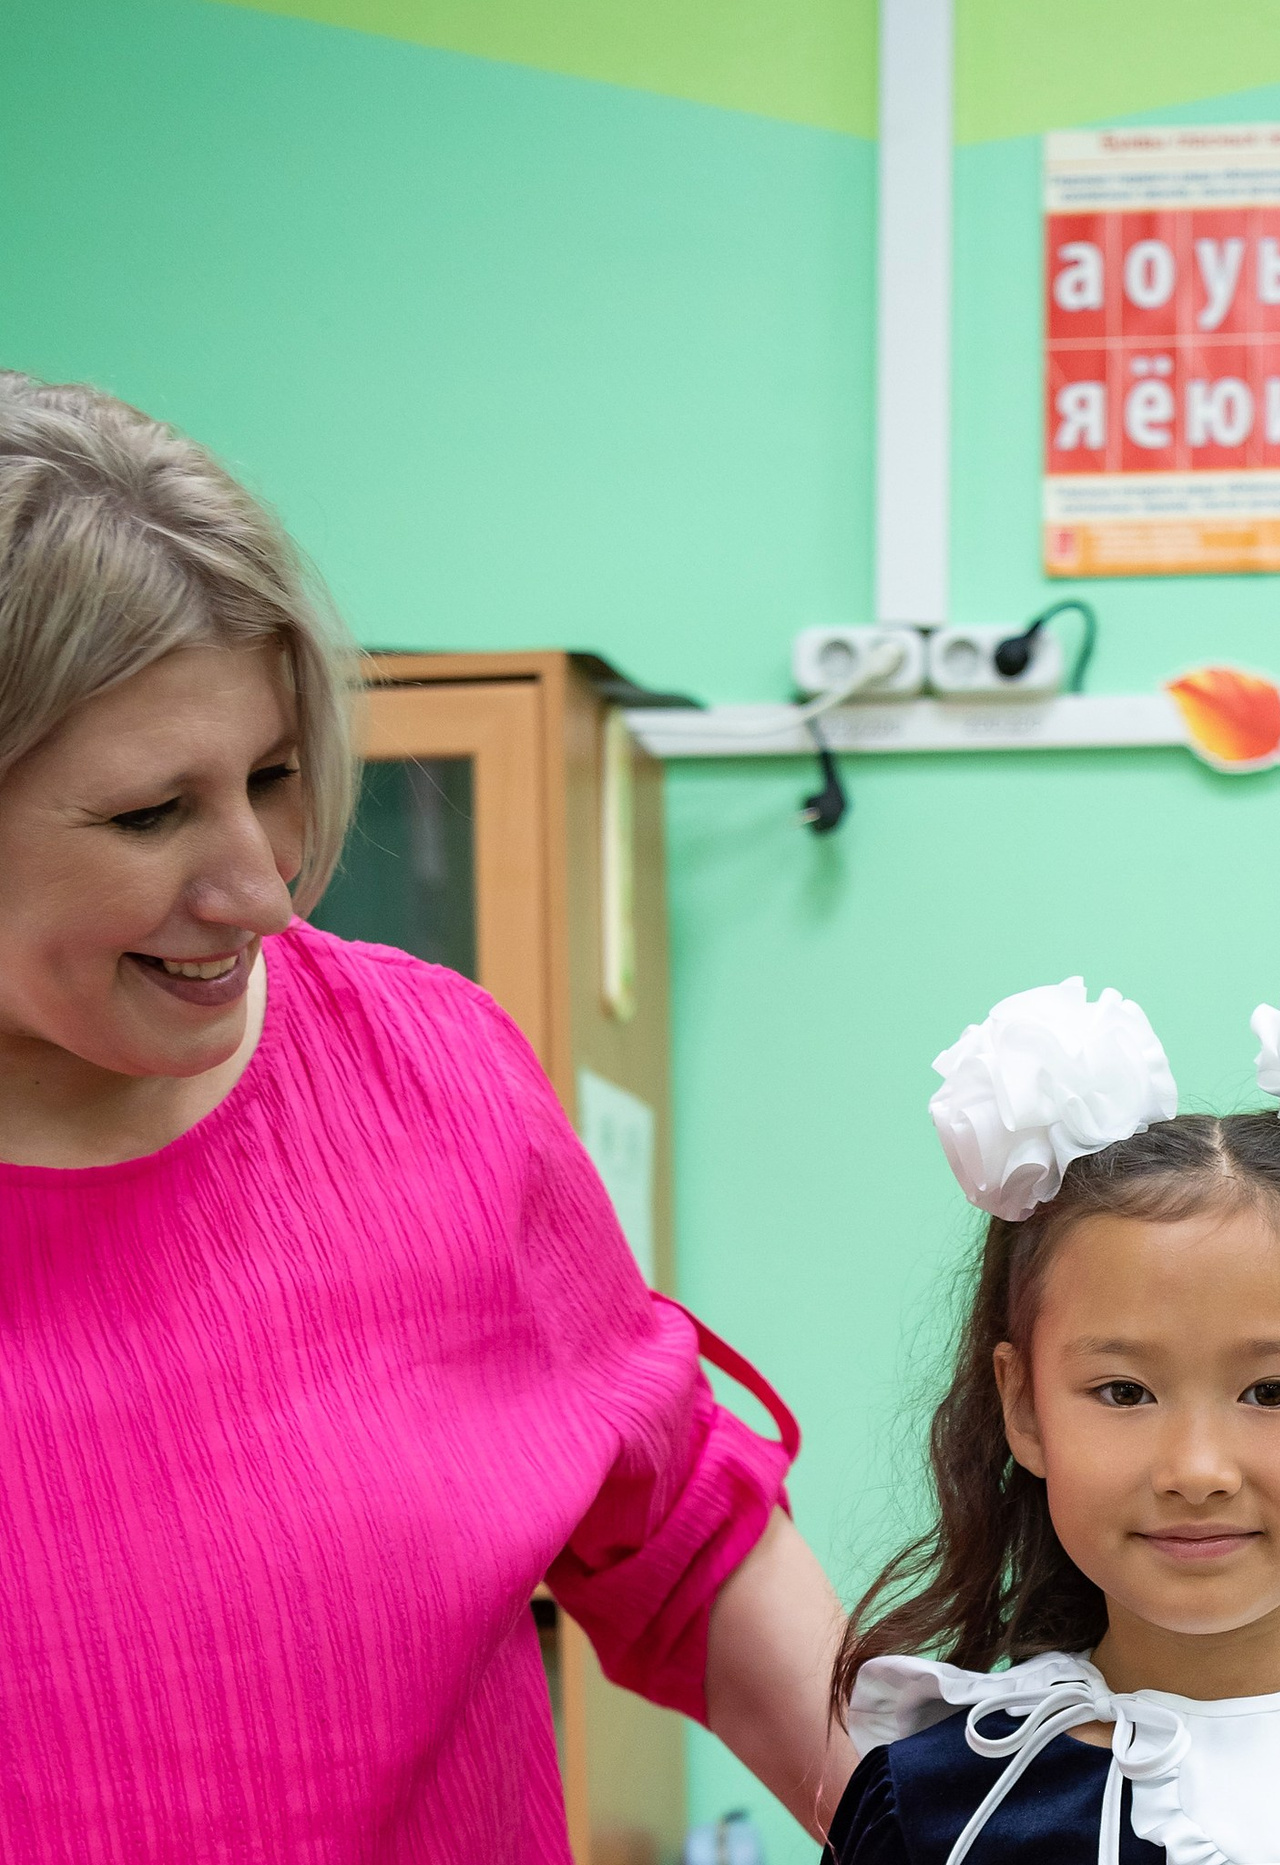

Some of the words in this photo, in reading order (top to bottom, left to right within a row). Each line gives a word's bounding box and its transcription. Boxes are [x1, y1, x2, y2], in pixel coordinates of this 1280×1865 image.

[1054, 242, 1104, 310] а
[1125, 240, 1176, 308] о
[1197, 237, 1244, 329] у
[1056, 381, 1105, 450] я
[1124, 357, 1174, 448] ё
[1187, 378, 1253, 446] ю
